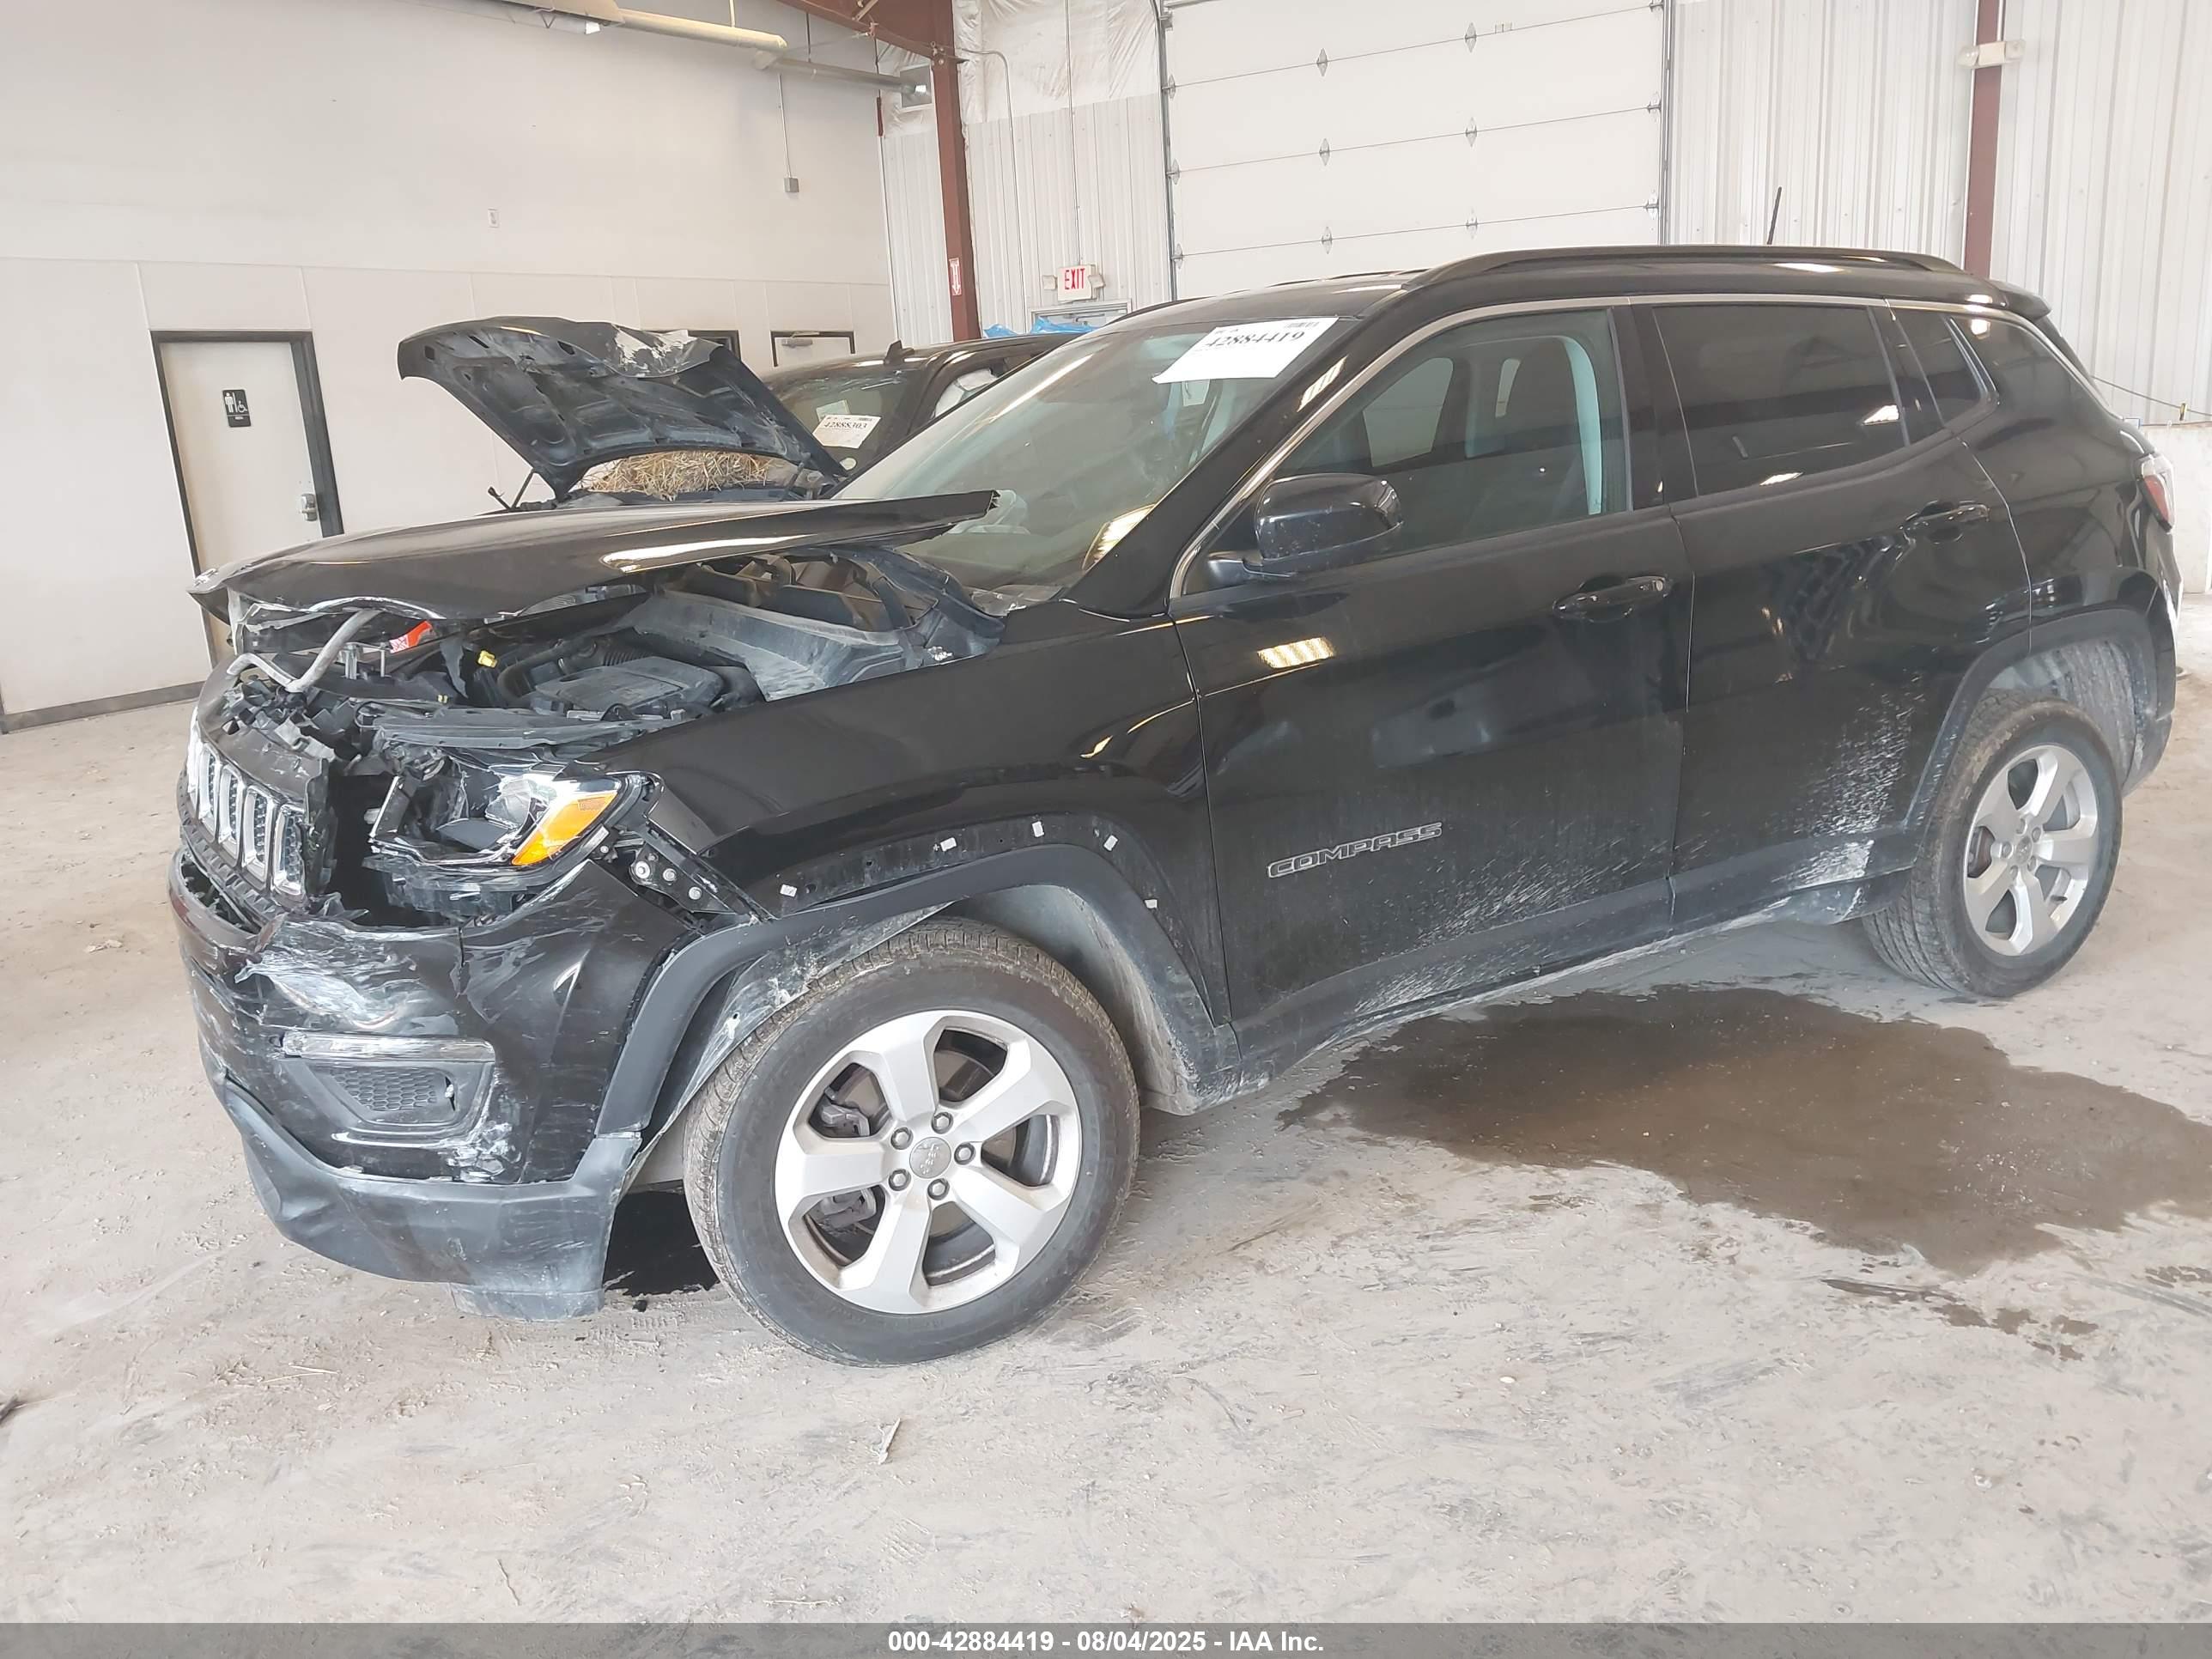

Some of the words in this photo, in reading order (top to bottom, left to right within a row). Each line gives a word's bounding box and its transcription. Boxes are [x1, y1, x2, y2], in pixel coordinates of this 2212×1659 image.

[1064, 268, 1085, 290] EXIT
[1205, 331, 1305, 348] 42884419
[1267, 822, 1443, 878] COMPASS
